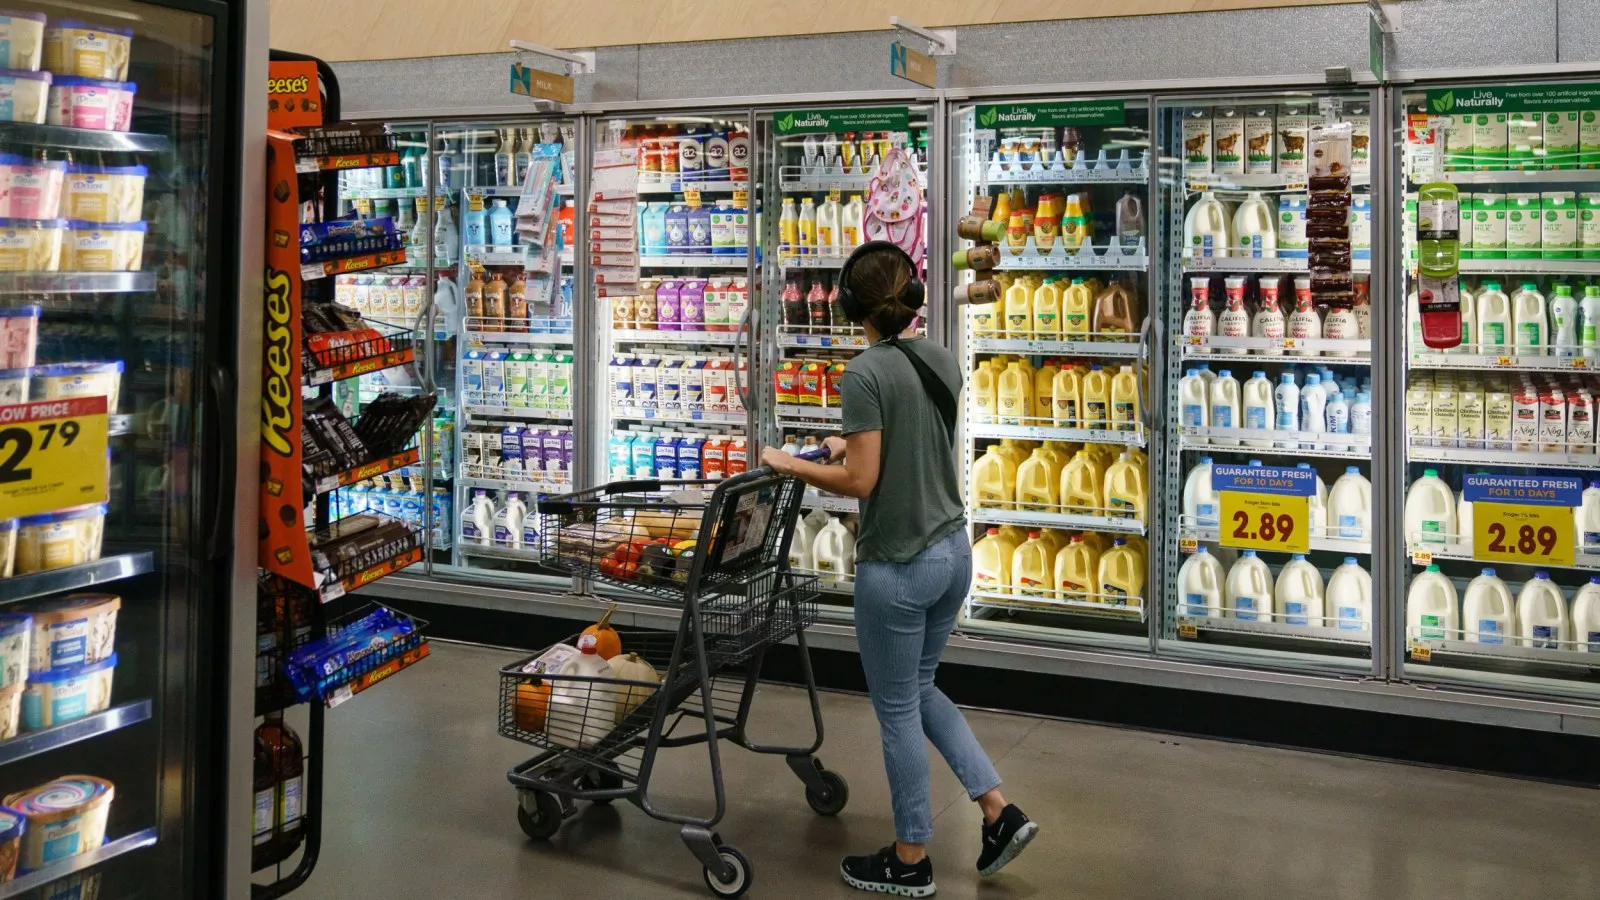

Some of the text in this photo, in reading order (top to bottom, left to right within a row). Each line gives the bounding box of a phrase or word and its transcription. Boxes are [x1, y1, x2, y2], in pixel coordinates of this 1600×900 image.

[267, 75, 309, 94] eese's
[536, 79, 552, 90] MILK
[1473, 90, 1493, 99] Live
[1455, 97, 1504, 108] Naturally
[1012, 106, 1027, 114] Live
[807, 113, 821, 121] Live
[998, 113, 1036, 122] Naturally
[794, 119, 829, 128] Naturally
[0, 402, 69, 422] OW PRICE
[1514, 425, 1537, 436] Nog
[1541, 426, 1565, 437] Nog
[1568, 427, 1592, 438] Nog
[1215, 467, 1312, 479] GUARANTEED FRESH
[1234, 477, 1293, 487] FOR 10 DAYS
[1467, 477, 1577, 490] GUARANTEED FRESH
[1488, 487, 1556, 498] FOR 10 DAYS
[1232, 510, 1294, 543] 2.89
[1487, 522, 1557, 556] 2.89
[1414, 552, 1431, 560] 2.89
[1413, 647, 1430, 656] 2.89
